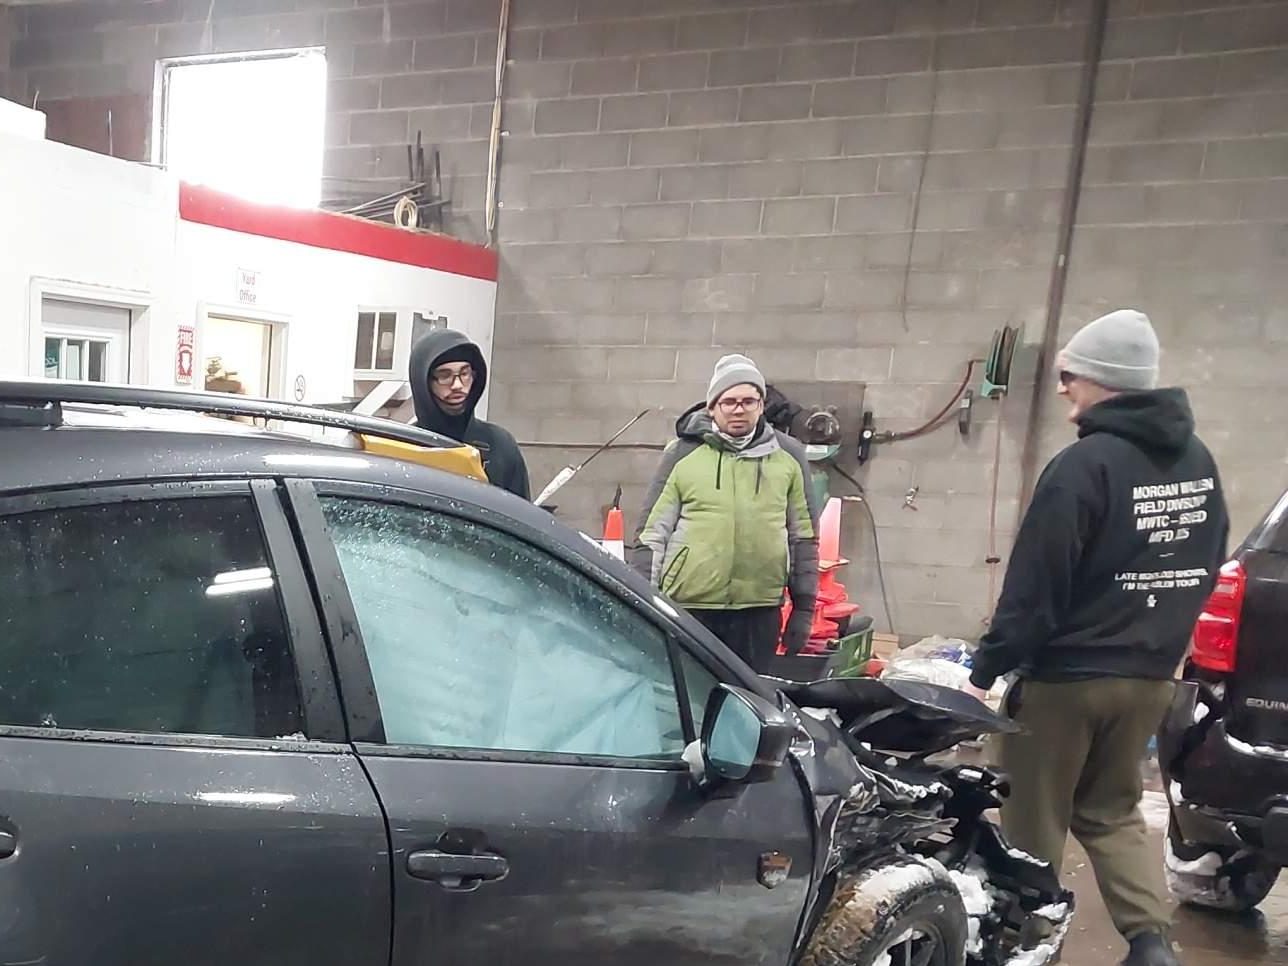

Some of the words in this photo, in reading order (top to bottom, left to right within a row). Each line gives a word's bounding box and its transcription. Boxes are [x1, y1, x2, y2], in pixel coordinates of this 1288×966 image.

[1133, 484, 1179, 499] MORGAN
[1134, 501, 1166, 514] FIELD
[1114, 572, 1137, 581] LATE
